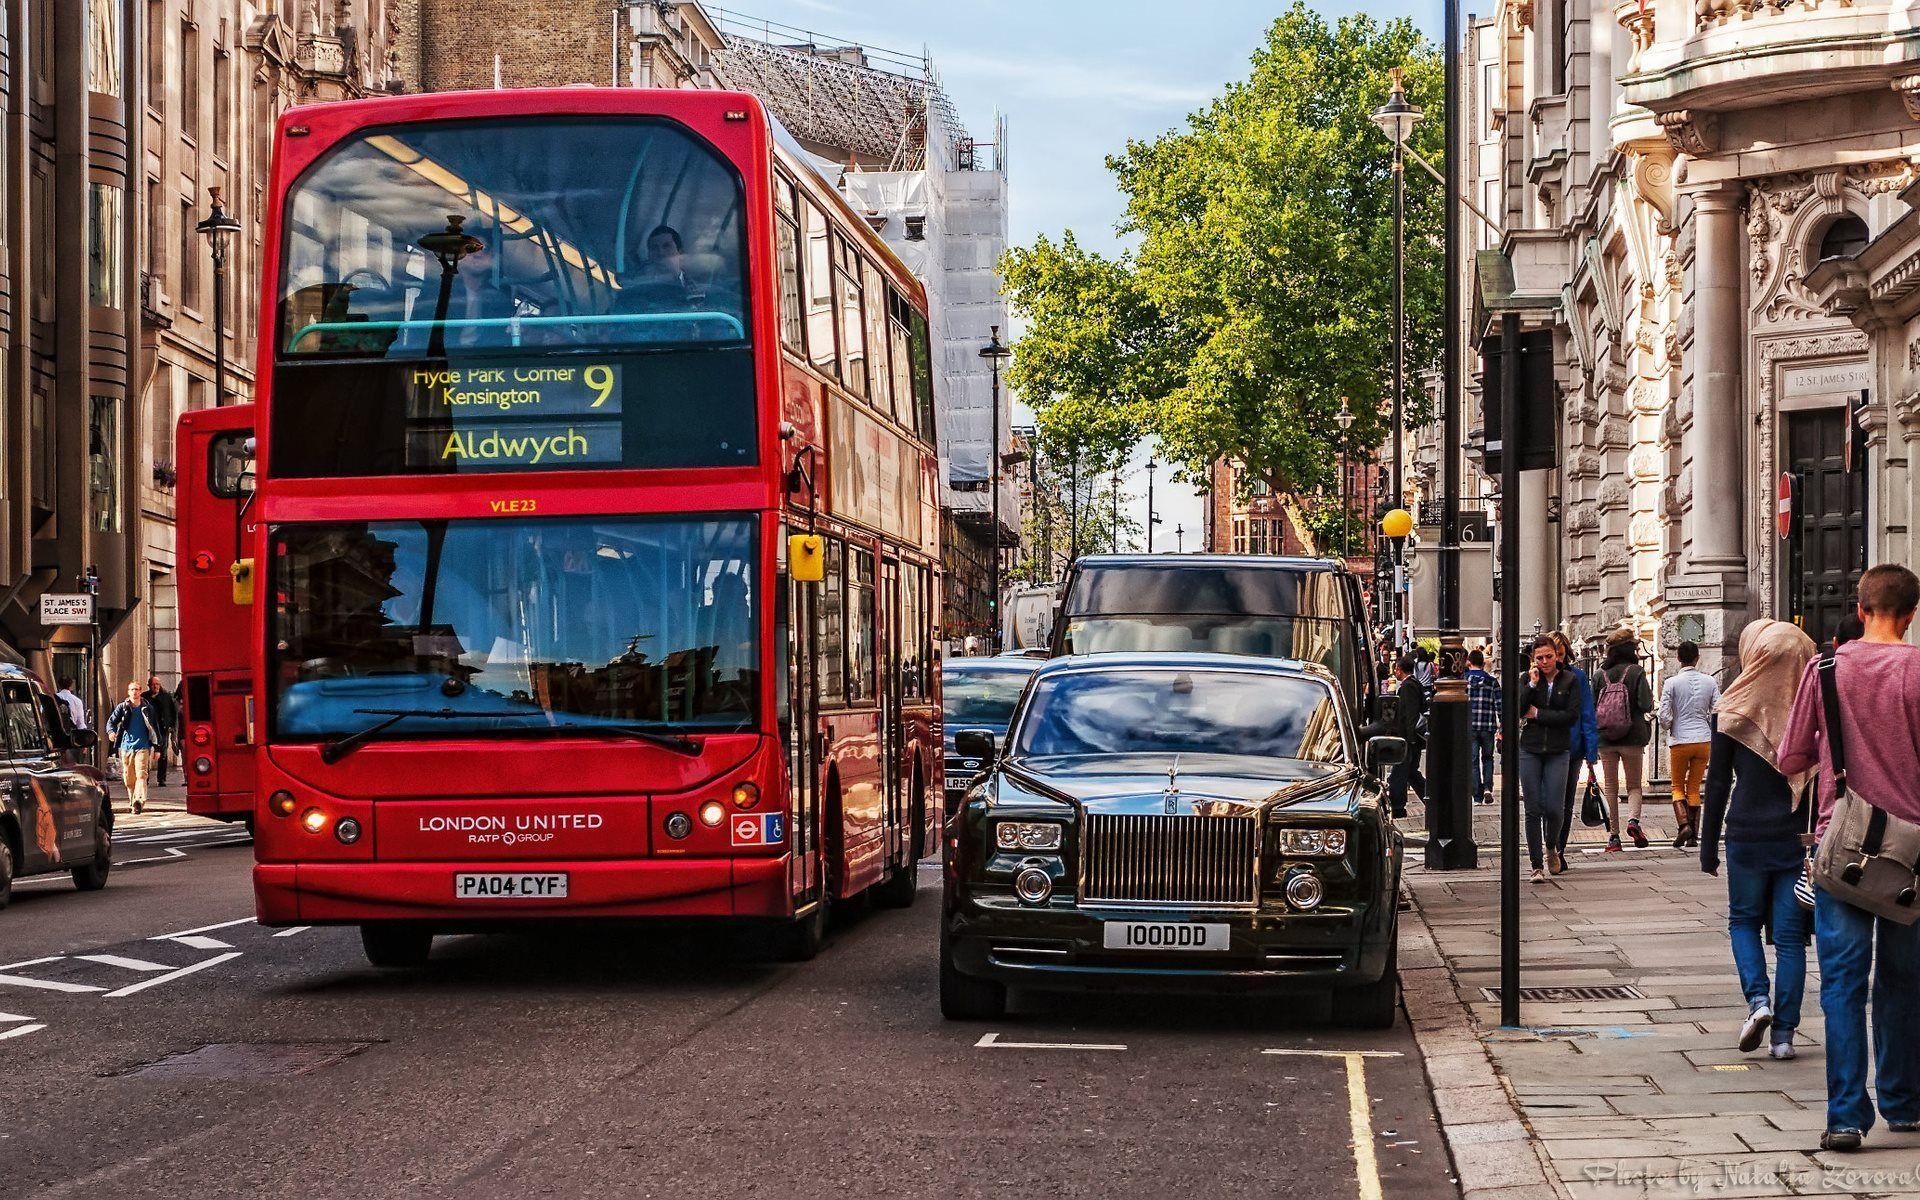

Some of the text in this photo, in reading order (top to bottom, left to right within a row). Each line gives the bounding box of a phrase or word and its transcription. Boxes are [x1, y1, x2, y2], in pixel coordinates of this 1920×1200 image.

[413, 367, 576, 389] Hyde Park Corner
[583, 364, 615, 408] 9
[443, 387, 540, 410] Kensington
[441, 427, 588, 465] Aldwych
[1462, 523, 1474, 543] 6
[1673, 588, 1712, 597] RESTAURANT
[44, 607, 87, 615] PLACE SW1
[58, 598, 87, 607] JAMES'S
[419, 814, 603, 831] LONDON UNITED
[468, 833, 554, 843] RATP GROUP
[463, 876, 560, 895] PA04 CYF
